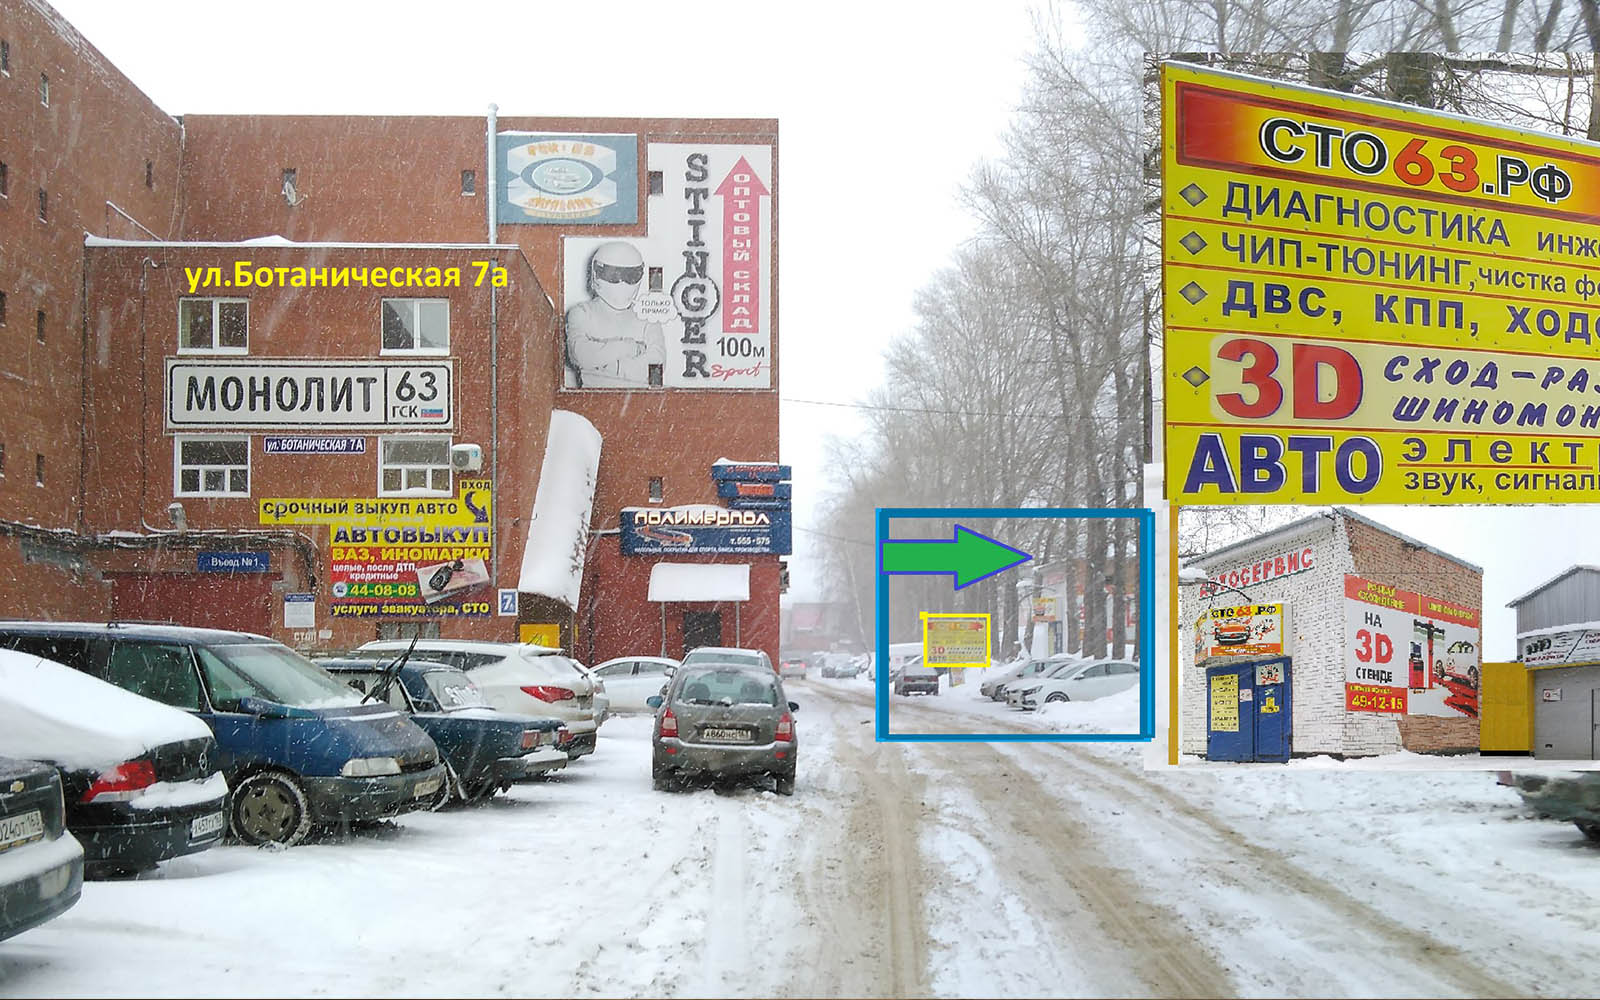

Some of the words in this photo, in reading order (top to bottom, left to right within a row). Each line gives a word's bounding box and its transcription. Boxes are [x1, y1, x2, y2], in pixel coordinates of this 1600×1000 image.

[1259, 116, 1572, 204] СТО63.РФ
[732, 173, 752, 261] ОПТОВЫЙ
[1222, 181, 1511, 247] ДИАГНОСТИКА
[1537, 231, 1600, 258] инж
[681, 153, 710, 378] STINGER
[1575, 273, 1600, 301] ф
[731, 271, 752, 329] СКЛАД
[1222, 279, 1343, 326] ДВС,
[1375, 293, 1480, 337] КПП,
[1506, 305, 1600, 346] ХОД
[711, 361, 771, 381] Sport
[1216, 338, 1364, 420] 3D
[186, 375, 377, 412] МОНОЛИТ
[395, 370, 438, 402] 63
[392, 405, 418, 418] ГСК
[281, 438, 347, 451] БОТАНИЧЕСКАЯ
[350, 439, 363, 451] 7А
[1402, 437, 1600, 464] элект
[1182, 433, 1384, 494] АВТО
[461, 481, 490, 490] ВХОД
[1404, 471, 1485, 494] звук,
[1495, 472, 1600, 490] сигнал
[354, 502, 410, 515] ВЫКУП
[416, 502, 458, 515] АВТО
[333, 526, 489, 544] АВТОВЫКУП
[211, 557, 239, 567] Въезд
[242, 557, 258, 567] №1
[332, 548, 375, 563] ВАЗ,
[381, 548, 489, 561] ИНОМАРКИ
[333, 563, 365, 573] целые,
[367, 564, 394, 573] после
[396, 563, 418, 573] ДТП,
[349, 573, 399, 582] кредитные
[350, 584, 417, 596] 44-08-08
[333, 603, 378, 616] услуги
[462, 603, 489, 614] СТО
[1364, 611, 1382, 628] НА
[1355, 629, 1393, 664] 3D
[1356, 667, 1393, 684] СТЕНДЕ
[1351, 694, 1404, 710] 49-12-15
